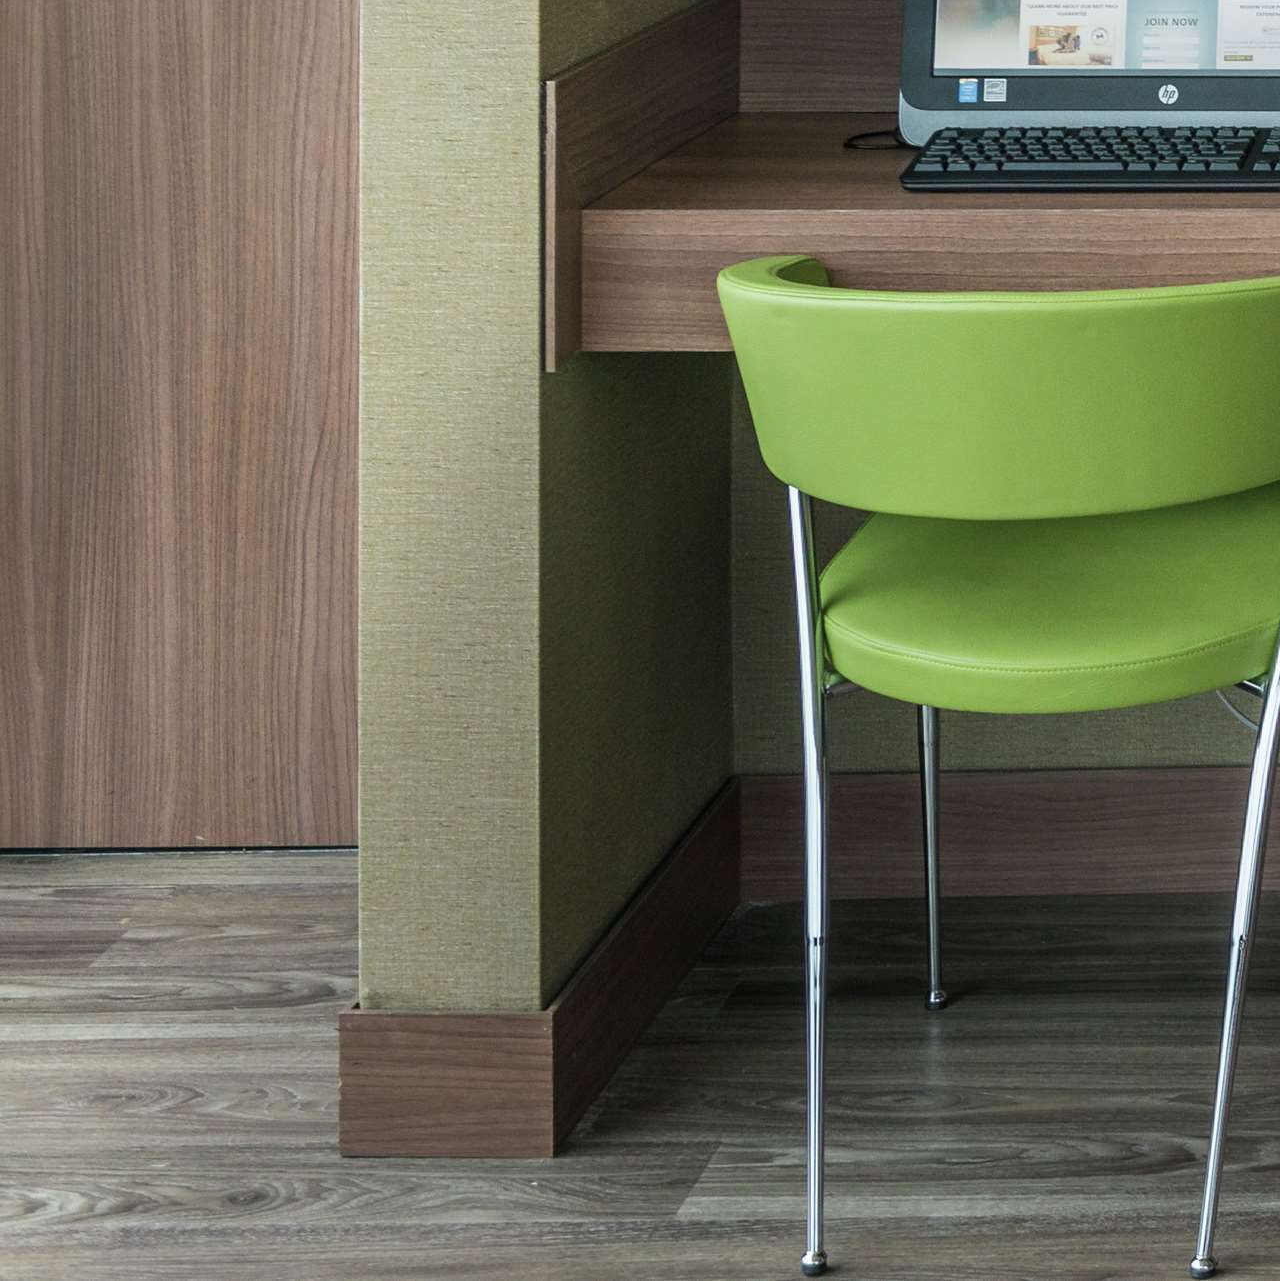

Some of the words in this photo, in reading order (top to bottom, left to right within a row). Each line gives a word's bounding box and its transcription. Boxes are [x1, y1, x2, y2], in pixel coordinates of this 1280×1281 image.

[1144, 18, 1169, 27] JOIN
[1171, 18, 1199, 26] NOW
[1160, 85, 1177, 104] hp
